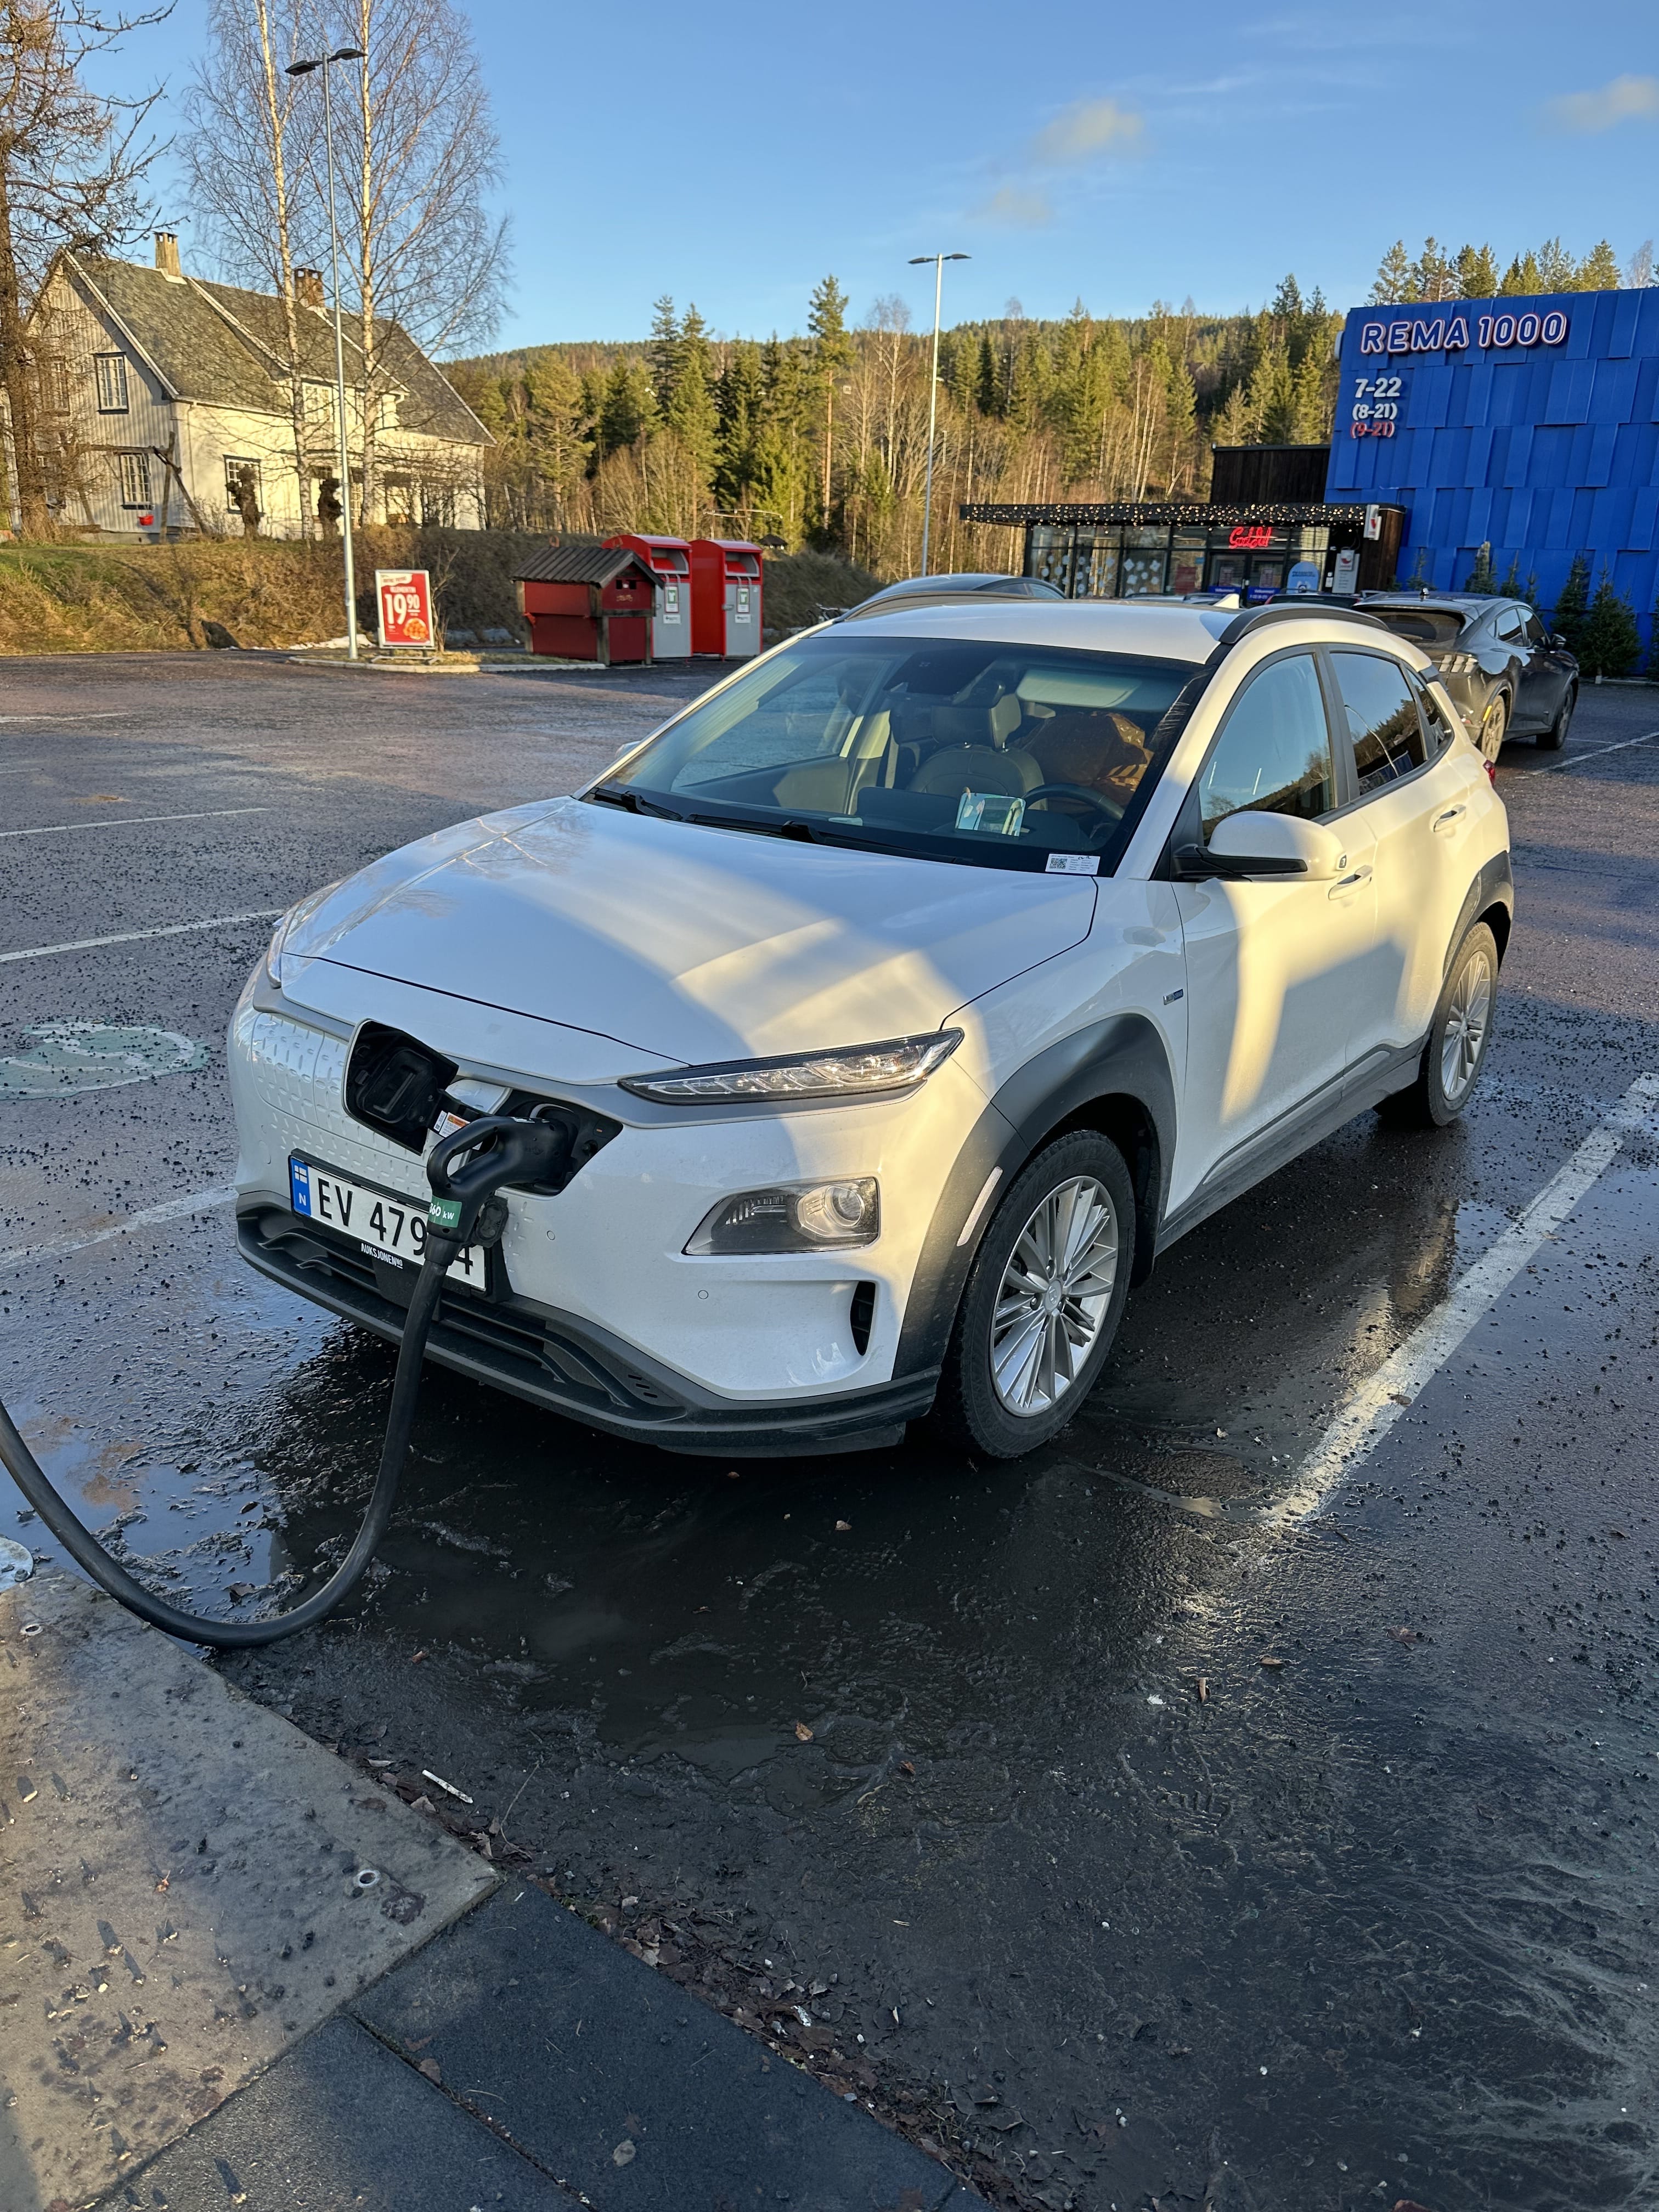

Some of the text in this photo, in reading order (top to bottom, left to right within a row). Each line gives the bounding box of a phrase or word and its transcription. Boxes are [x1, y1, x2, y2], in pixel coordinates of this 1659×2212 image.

[1361, 312, 1567, 353] REMA 1000
[1355, 377, 1402, 398] 7-22
[1352, 402, 1398, 420] (8-21)
[1350, 421, 1395, 438] (9-21)
[299, 1192, 307, 1206] N
[443, 1211, 454, 1220] kW
[318, 1177, 473, 1276] EV 4794
